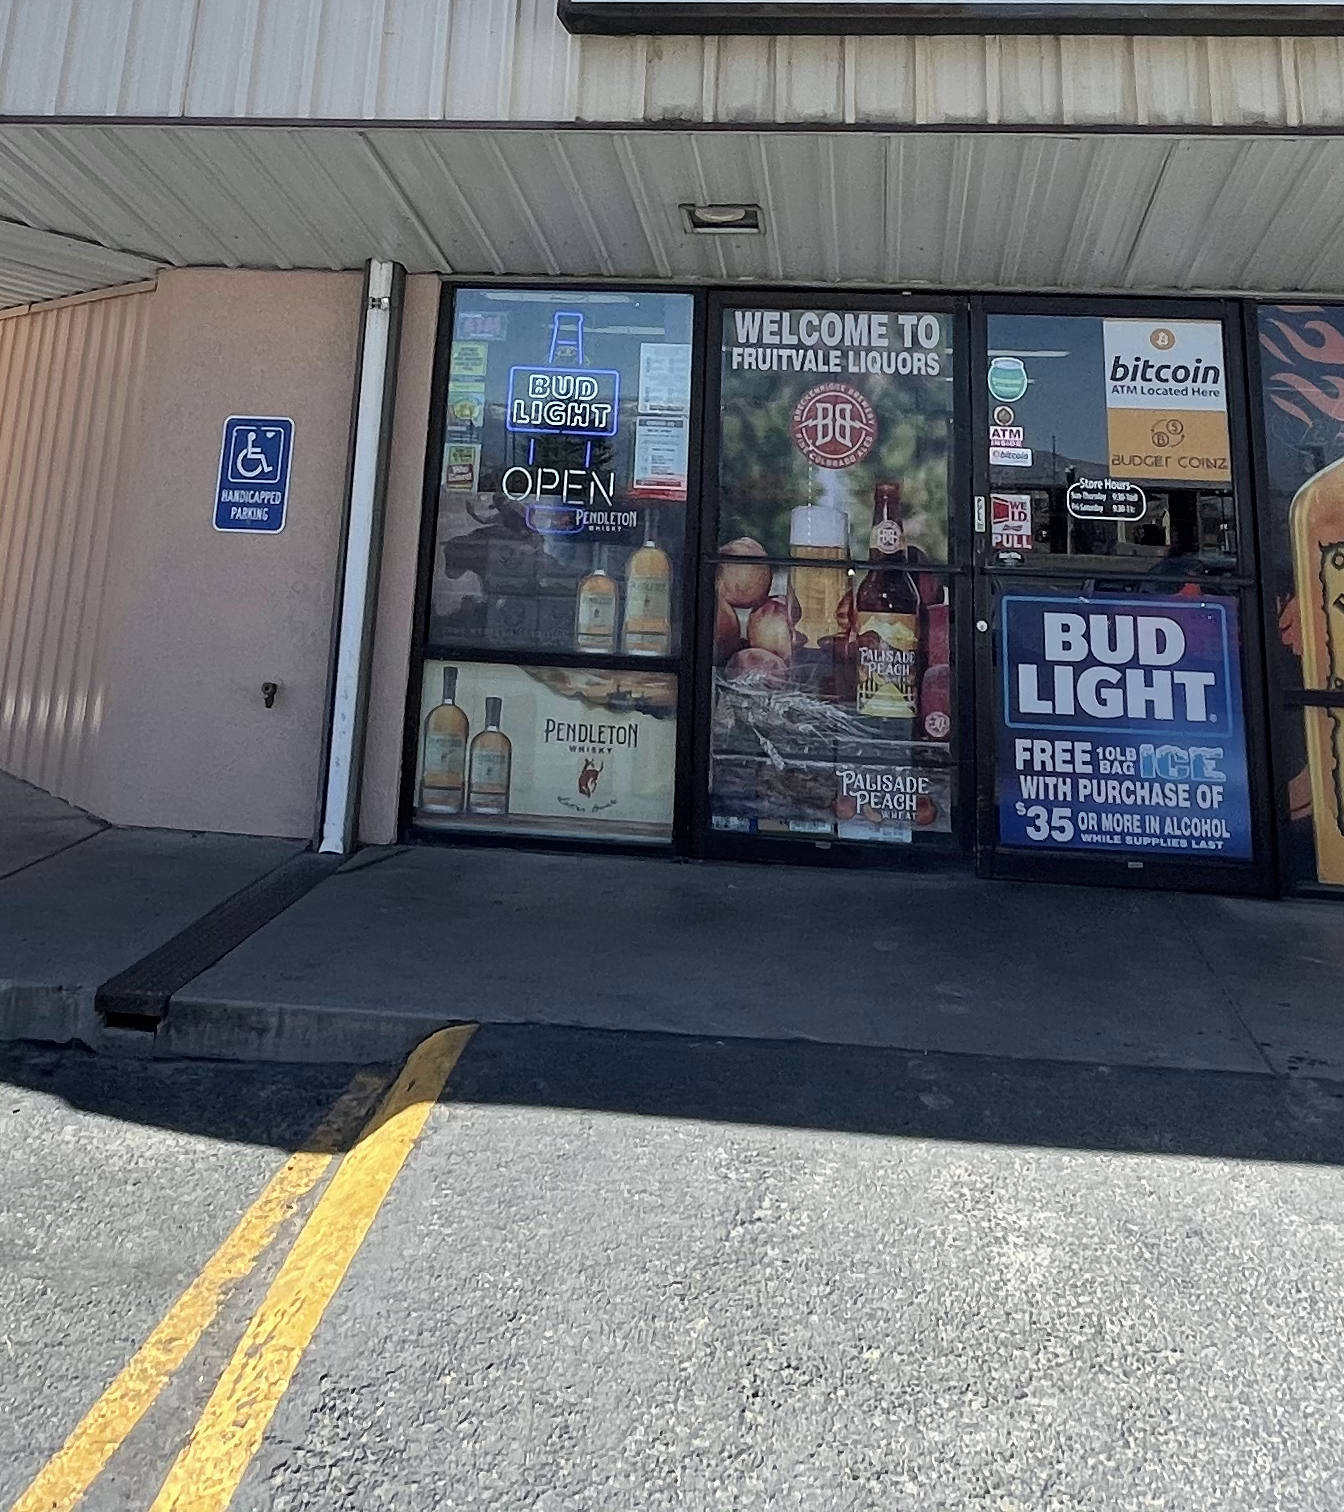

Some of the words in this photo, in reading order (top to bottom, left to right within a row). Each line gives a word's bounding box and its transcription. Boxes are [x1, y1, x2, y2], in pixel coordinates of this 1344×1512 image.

[734, 311, 888, 347] WELCOME
[898, 314, 941, 349] TO
[732, 347, 842, 372] FRUITVALE
[847, 350, 941, 376] LIQUORS
[1109, 355, 1220, 384] bitcoin
[528, 374, 598, 401] BUD
[1111, 385, 1137, 396] ATM
[1140, 385, 1188, 397] Located
[1191, 387, 1220, 398] Here
[512, 399, 611, 427] LIGHT
[991, 428, 1021, 439] ATM
[1111, 454, 1171, 468] BUDGET
[1178, 456, 1229, 470] COINZ
[502, 466, 615, 506] OPEN
[1079, 477, 1103, 490] Store
[1104, 478, 1131, 491] Hours
[221, 489, 282, 504] HANDICAPPED
[1010, 501, 1027, 510] WE
[230, 507, 269, 521] PARKING
[576, 509, 637, 527] PENDLETON
[992, 534, 1032, 550] PULL
[1044, 612, 1186, 666] BUD
[859, 647, 916, 665] PALISADE
[865, 662, 911, 678] PEACH
[1018, 664, 1215, 722] LIGHT
[544, 718, 639, 748] PENDLETON
[569, 745, 613, 754] WHISKY
[1015, 738, 1093, 774] FREE
[1096, 746, 1137, 762] 10LB
[1139, 743, 1227, 782] ICE
[1098, 761, 1135, 775] BAG
[836, 770, 929, 796] PALISADE
[1019, 775, 1072, 801] WITH
[1078, 779, 1191, 808] PURCHASE
[1196, 784, 1224, 809] OF
[849, 790, 917, 813] PEACH
[881, 810, 918, 821] WHEAT
[1015, 801, 1075, 842] $35
[1077, 811, 1098, 831] OR
[1101, 812, 1141, 834] MORE
[1145, 814, 1161, 834] IN
[1164, 816, 1231, 838] ALCOHOL
[1080, 833, 1122, 844] WHILE
[1124, 835, 1188, 848] SUPPLIES
[1191, 839, 1224, 849] LAST
